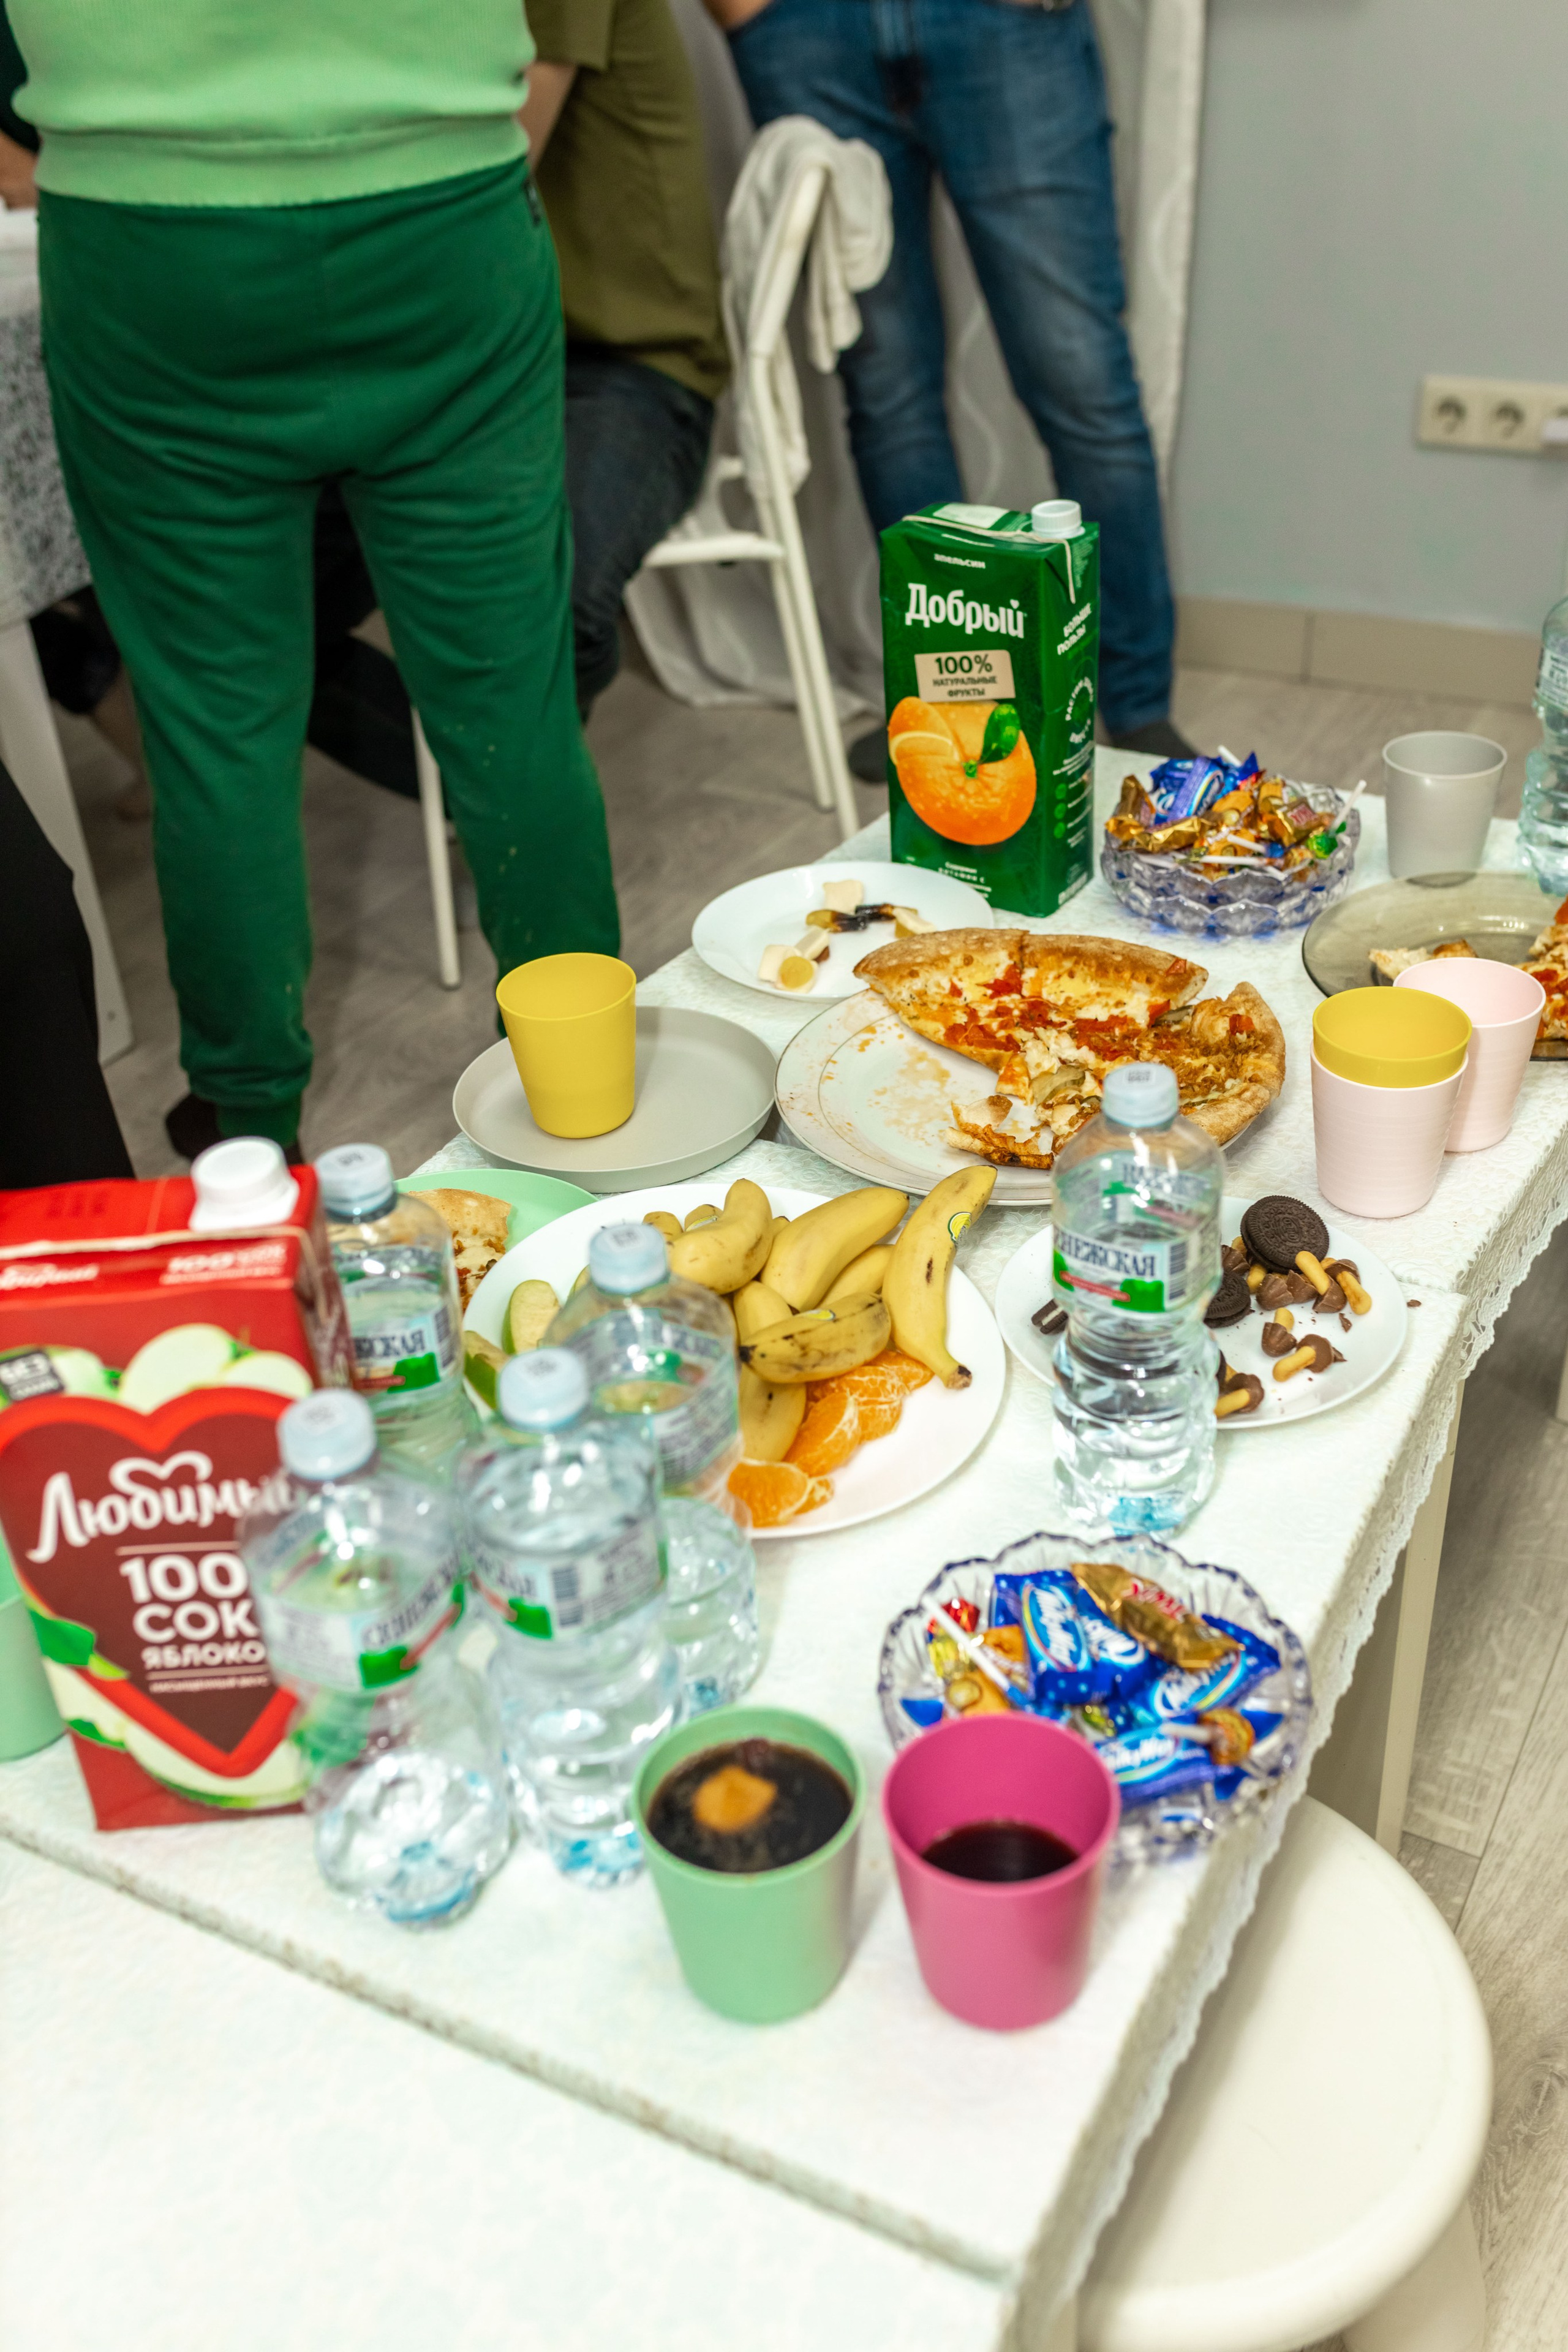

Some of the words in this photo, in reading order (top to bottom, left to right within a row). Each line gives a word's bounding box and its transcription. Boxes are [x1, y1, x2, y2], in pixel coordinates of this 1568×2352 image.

[934, 553, 986, 569] апельсин
[905, 582, 1025, 639] Добрый
[935, 654, 993, 675] 100%
[932, 676, 997, 687] НАТУРАЛЬНЫЕ
[947, 688, 986, 698] ФРУКТЫ
[26, 1450, 292, 1564] Любимый
[119, 1552, 248, 1604] 100
[133, 1599, 260, 1643] СОК
[141, 1640, 266, 1669] ЯБЛОКО
